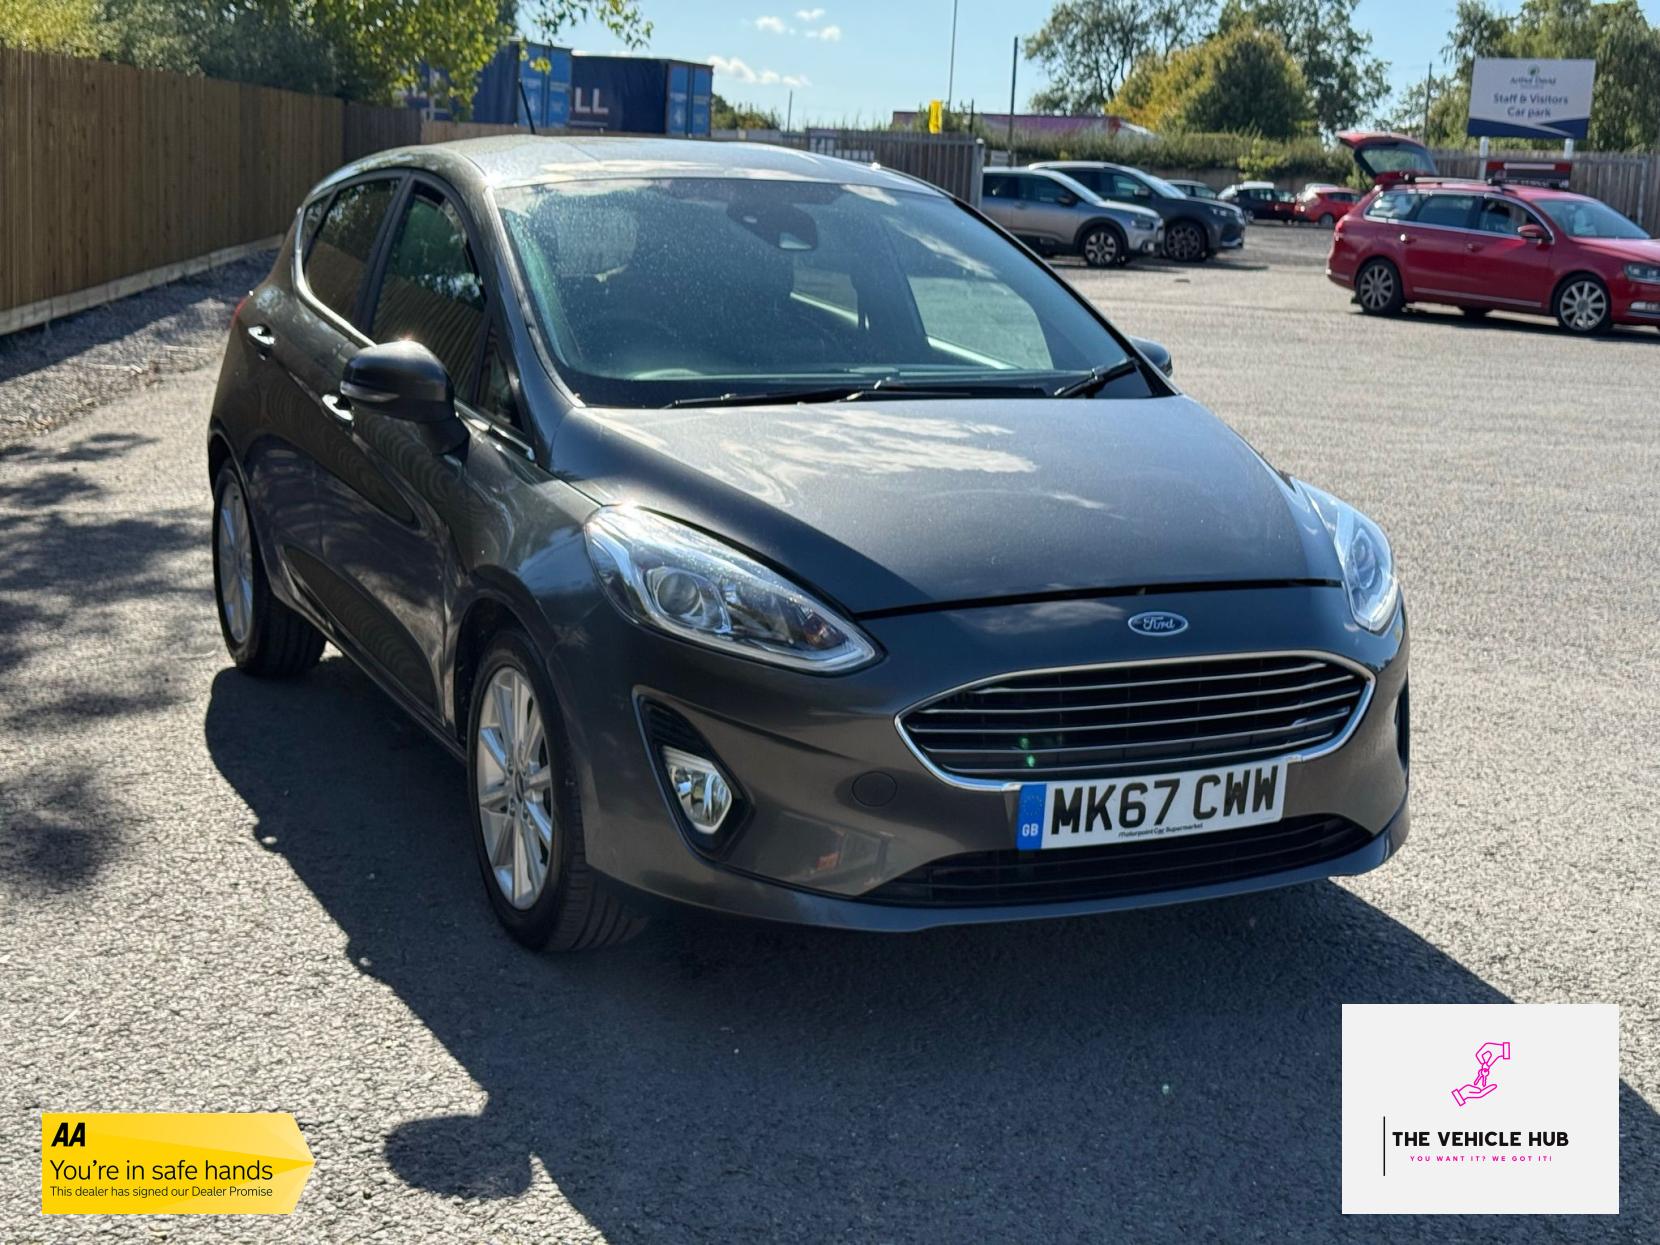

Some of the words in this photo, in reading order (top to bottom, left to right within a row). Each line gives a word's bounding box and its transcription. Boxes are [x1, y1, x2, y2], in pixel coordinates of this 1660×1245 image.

[1493, 92, 1518, 104] Staff
[1529, 94, 1568, 105] Visitors
[1507, 106, 1525, 117] Car
[1528, 107, 1551, 119] park
[1143, 616, 1175, 630] Ford
[1051, 779, 1180, 835] MK67
[1193, 765, 1278, 820] CWW
[1022, 823, 1039, 837] GB
[1166, 822, 1203, 834] Supermarket
